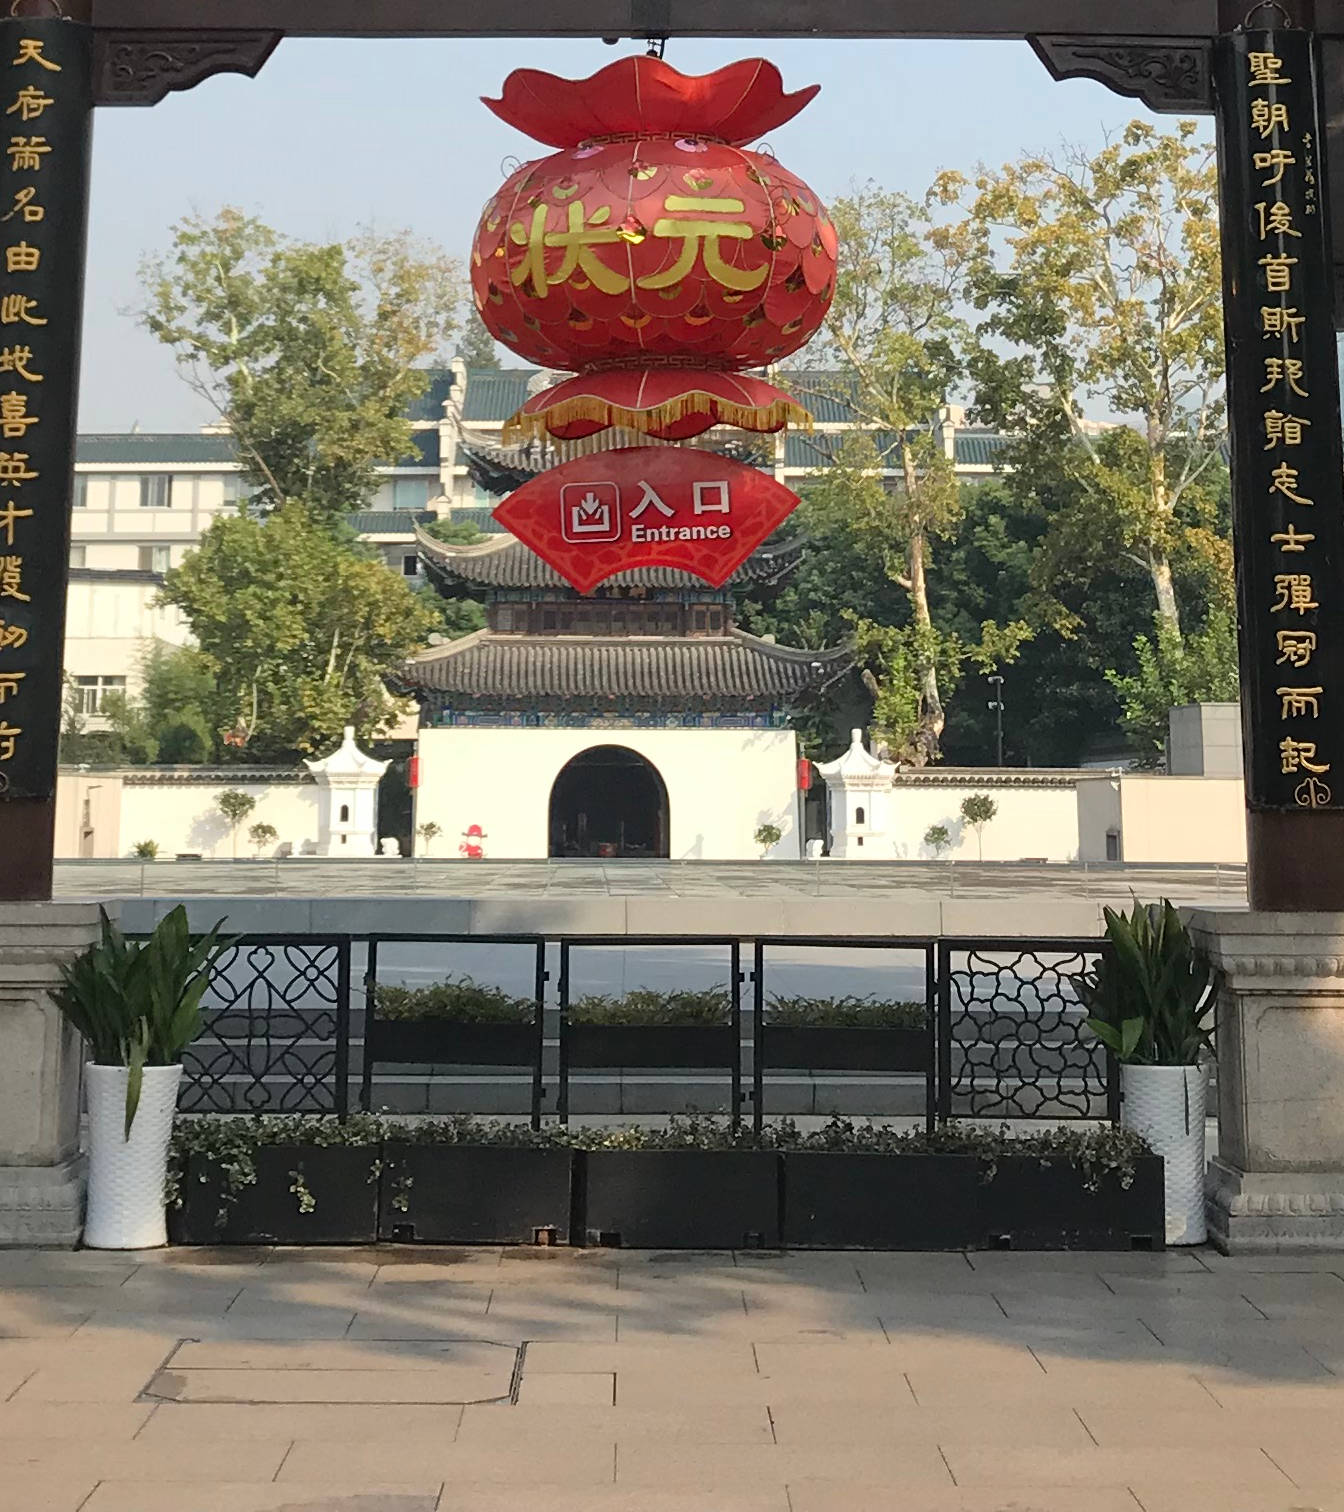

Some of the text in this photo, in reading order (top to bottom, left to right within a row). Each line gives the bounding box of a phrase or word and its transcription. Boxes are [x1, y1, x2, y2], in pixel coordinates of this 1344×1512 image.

[510, 196, 771, 299] 状元
[628, 480, 730, 519] 入口
[631, 524, 731, 542] Entrance
